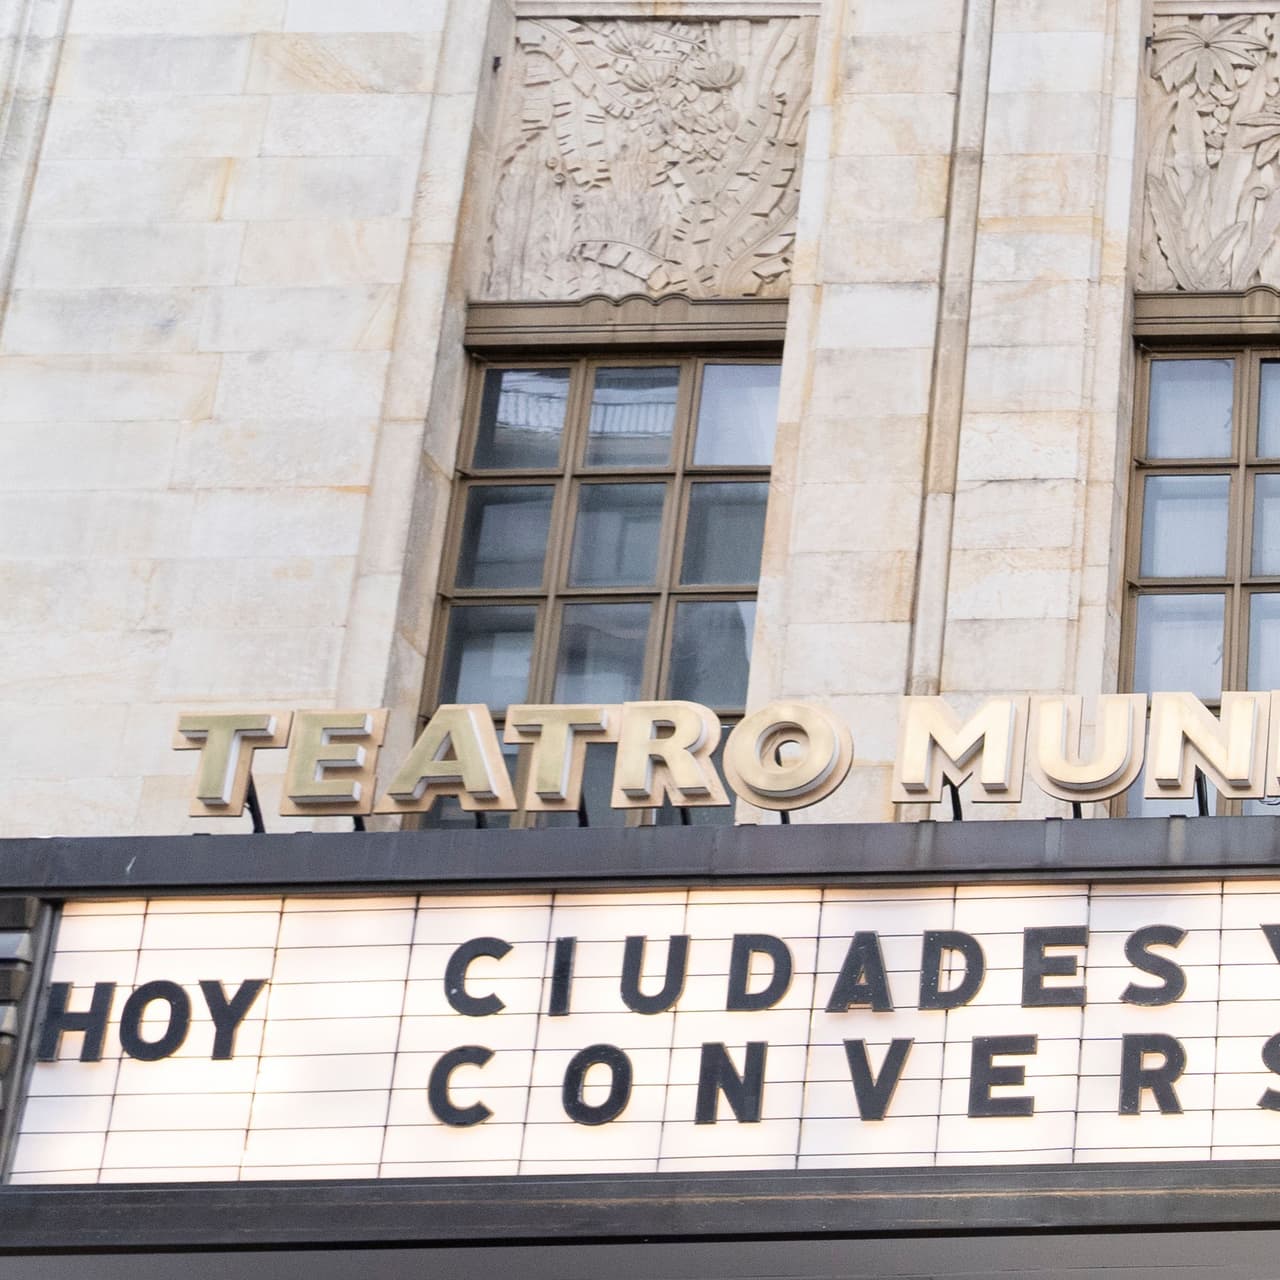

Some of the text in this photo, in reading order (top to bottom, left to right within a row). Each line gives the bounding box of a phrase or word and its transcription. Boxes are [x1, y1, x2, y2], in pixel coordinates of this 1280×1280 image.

[172, 700, 855, 818] TEATRO
[443, 922, 1189, 1018] CIUDADES
[37, 978, 268, 1064] HOY
